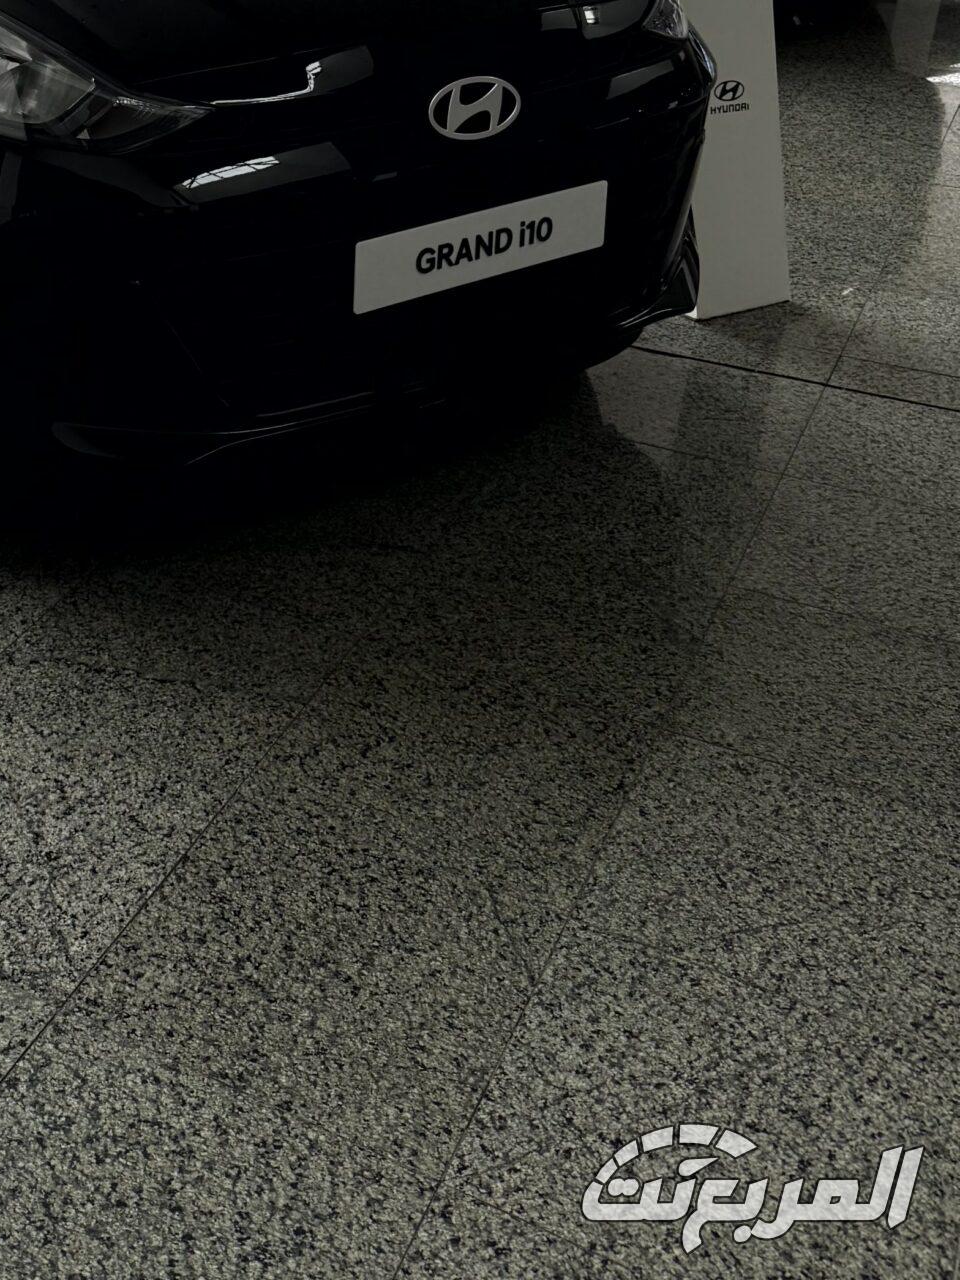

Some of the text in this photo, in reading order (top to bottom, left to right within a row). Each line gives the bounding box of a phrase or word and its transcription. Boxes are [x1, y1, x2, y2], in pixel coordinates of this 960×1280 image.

[710, 102, 749, 114] HYUNDAI
[416, 217, 553, 274] GRAND i10
